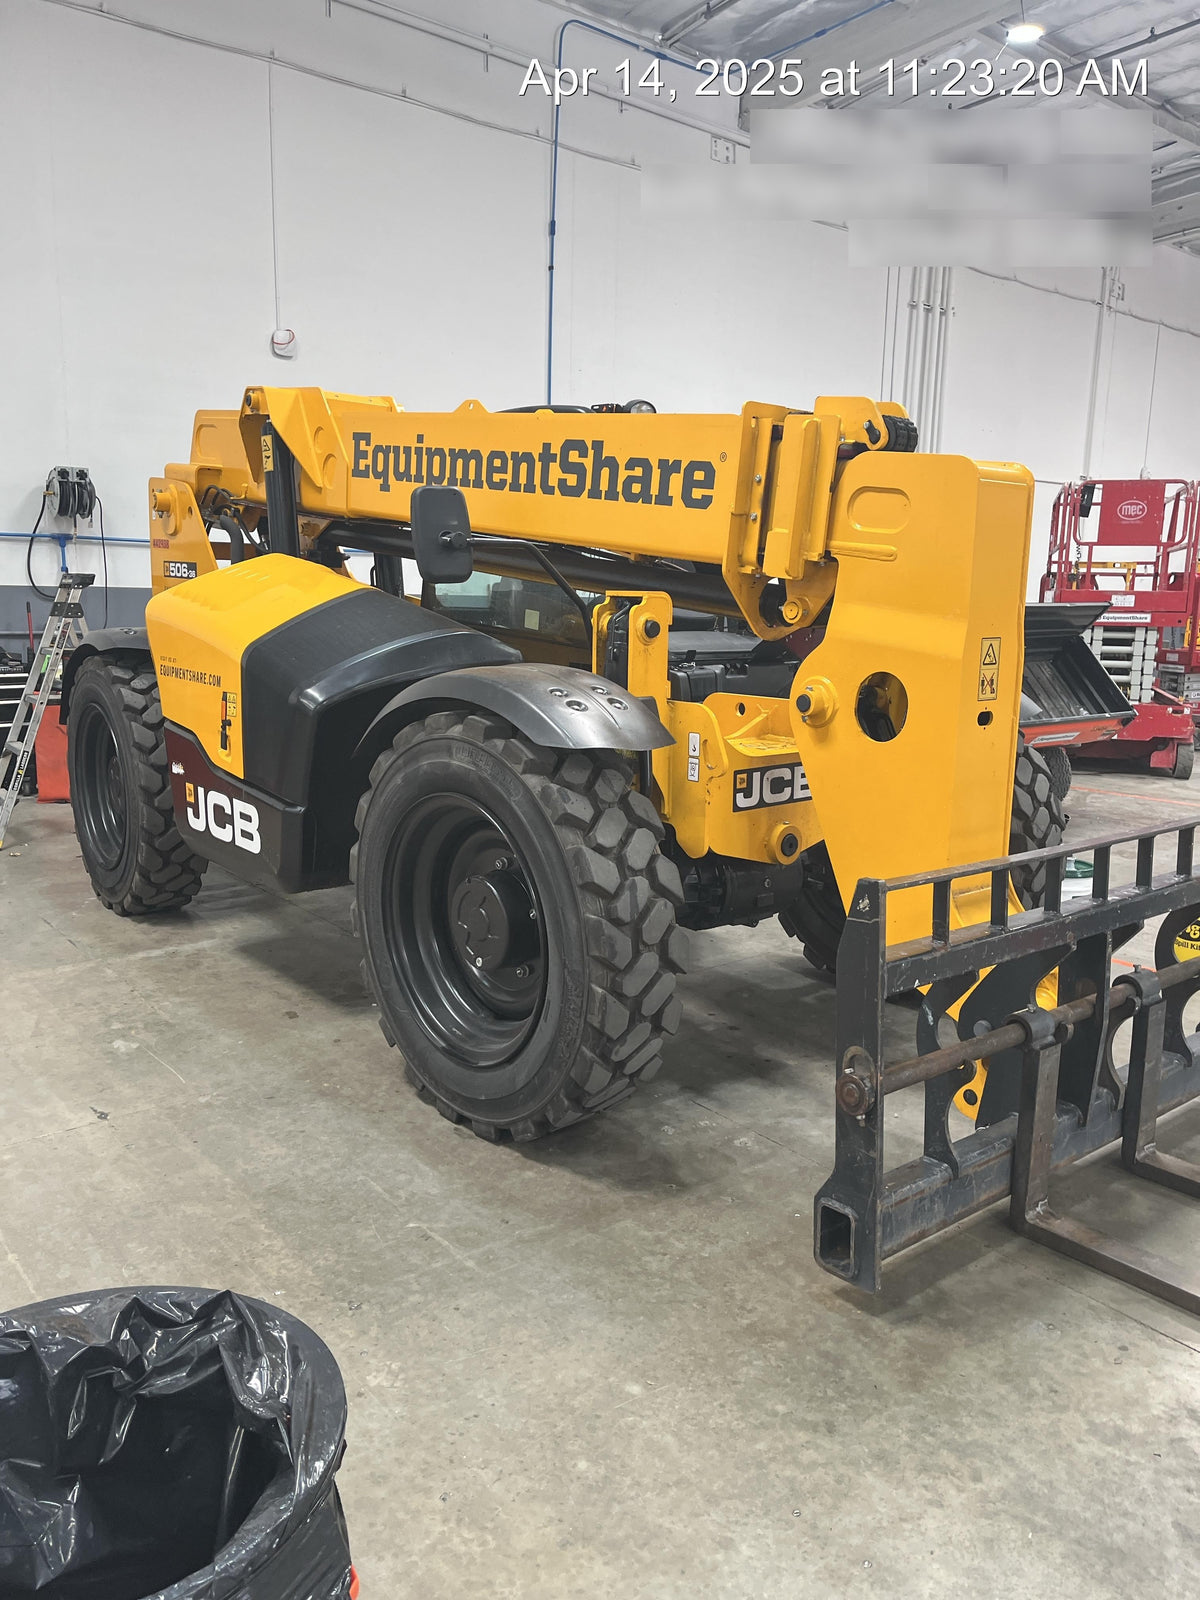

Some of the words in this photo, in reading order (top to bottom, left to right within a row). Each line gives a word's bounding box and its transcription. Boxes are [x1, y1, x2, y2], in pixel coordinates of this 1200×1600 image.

[352, 431, 716, 510] EquipmentShare
[1121, 503, 1144, 516] mec
[1102, 614, 1148, 622] EquipmentShare
[160, 664, 222, 688] EQUIPMENTSHARE.COM
[186, 786, 261, 854] JCB
